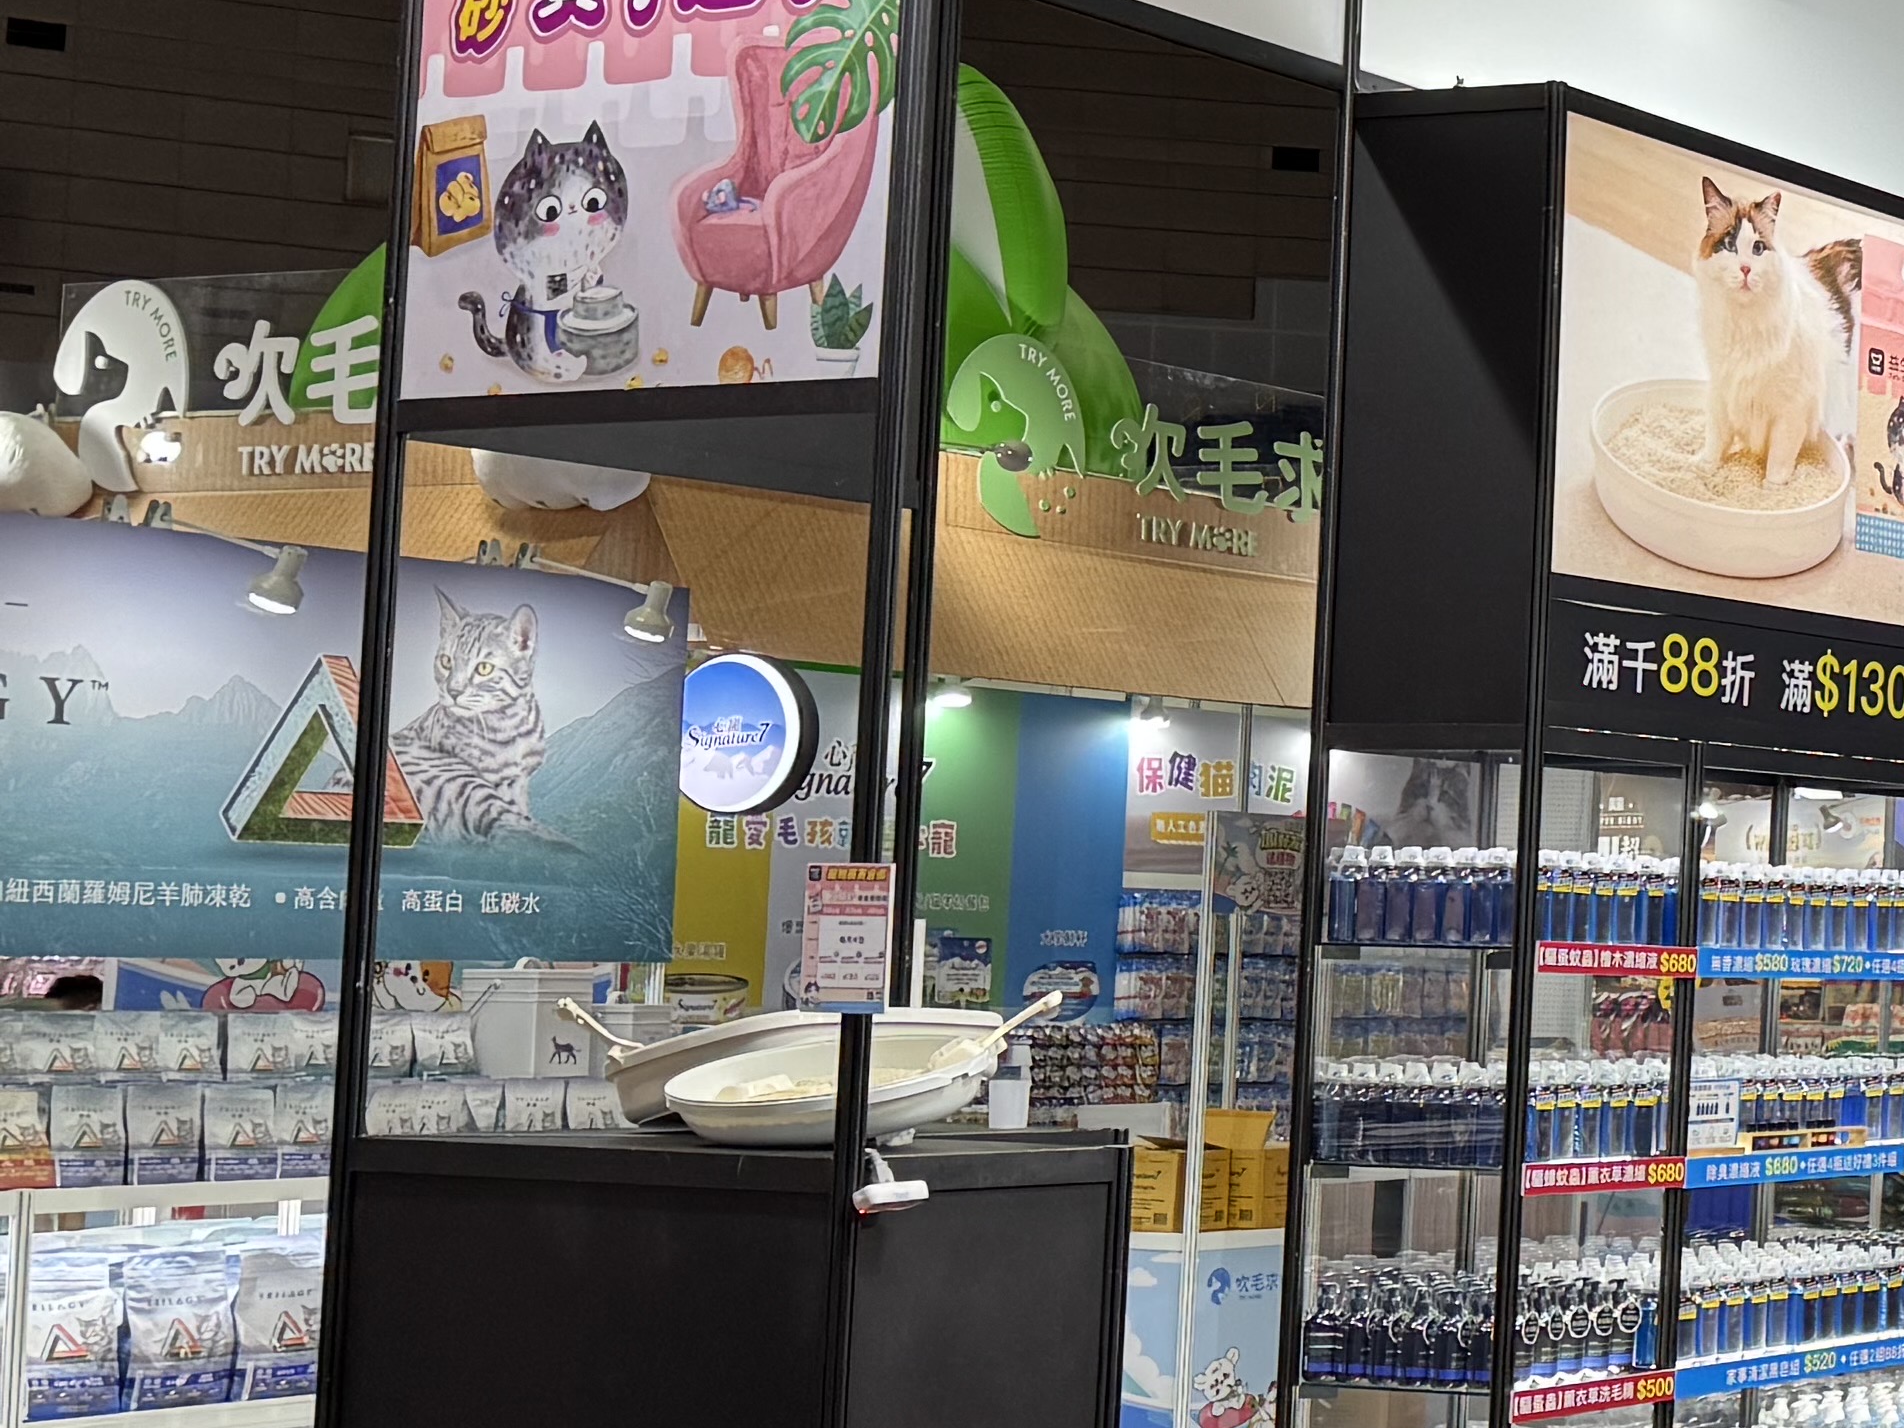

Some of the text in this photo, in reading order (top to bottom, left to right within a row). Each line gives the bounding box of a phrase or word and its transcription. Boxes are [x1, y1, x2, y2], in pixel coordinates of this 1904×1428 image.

[124, 289, 178, 362] TRY MORE
[1018, 343, 1077, 422] TRY MORE
[238, 444, 289, 476] TRY
[1138, 514, 1183, 547] TRY
[1582, 630, 1756, 707] 滿千88折
[687, 722, 771, 751] Signature7
[401, 888, 464, 914] 高蛋白
[479, 890, 542, 916] 低碳水
[1659, 952, 1696, 973] $680
[1832, 954, 1863, 973] $720
[1647, 1162, 1685, 1184] $680
[1803, 1351, 1837, 1374] $520
[1636, 1375, 1675, 1402] $500
